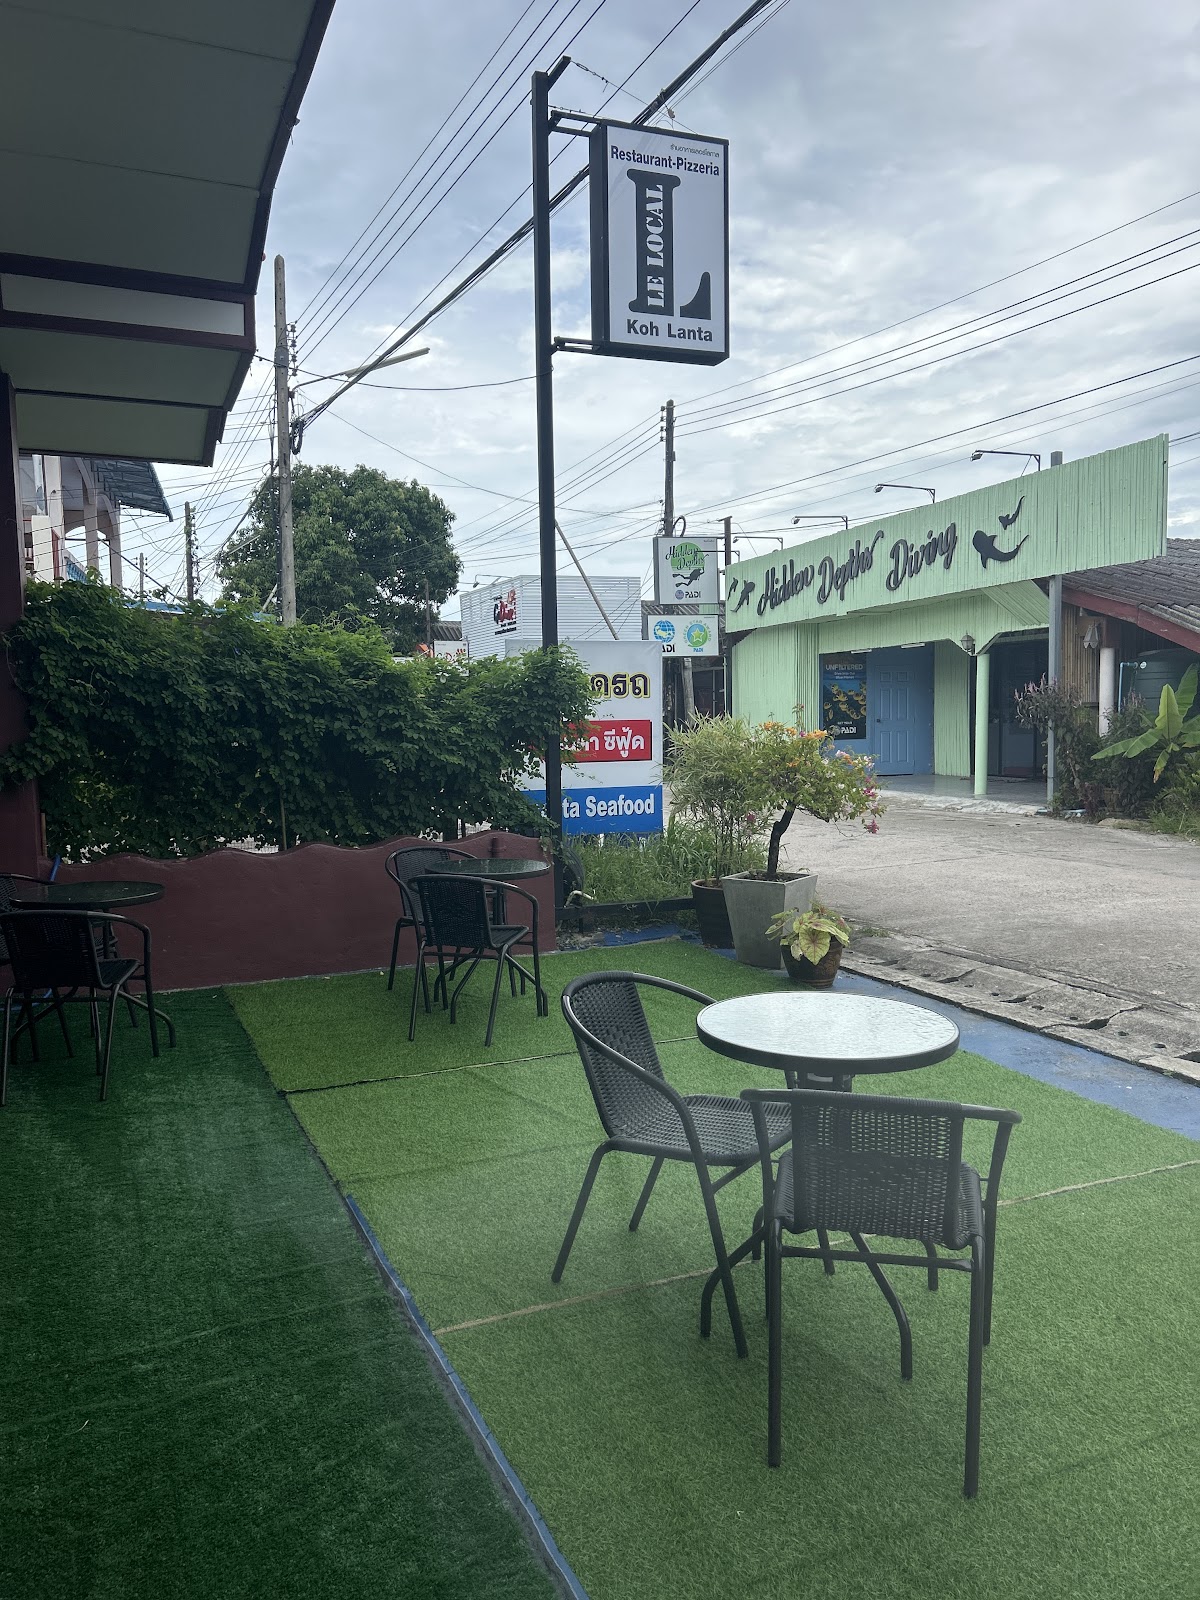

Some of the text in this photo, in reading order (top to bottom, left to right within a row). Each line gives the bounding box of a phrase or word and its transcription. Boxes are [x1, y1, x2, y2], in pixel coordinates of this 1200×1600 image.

[610, 145, 720, 176] Restaurant-Pizzeria
[646, 184, 665, 308] LE LOCAL
[626, 318, 713, 342] Koh Lanta
[665, 544, 700, 560] Hidden
[757, 521, 957, 616] Hidden Depths Diving
[662, 644, 676, 653] ADI
[590, 673, 649, 696] ดรถ
[840, 726, 857, 734] PADI
[561, 793, 655, 818] ta Seafood
